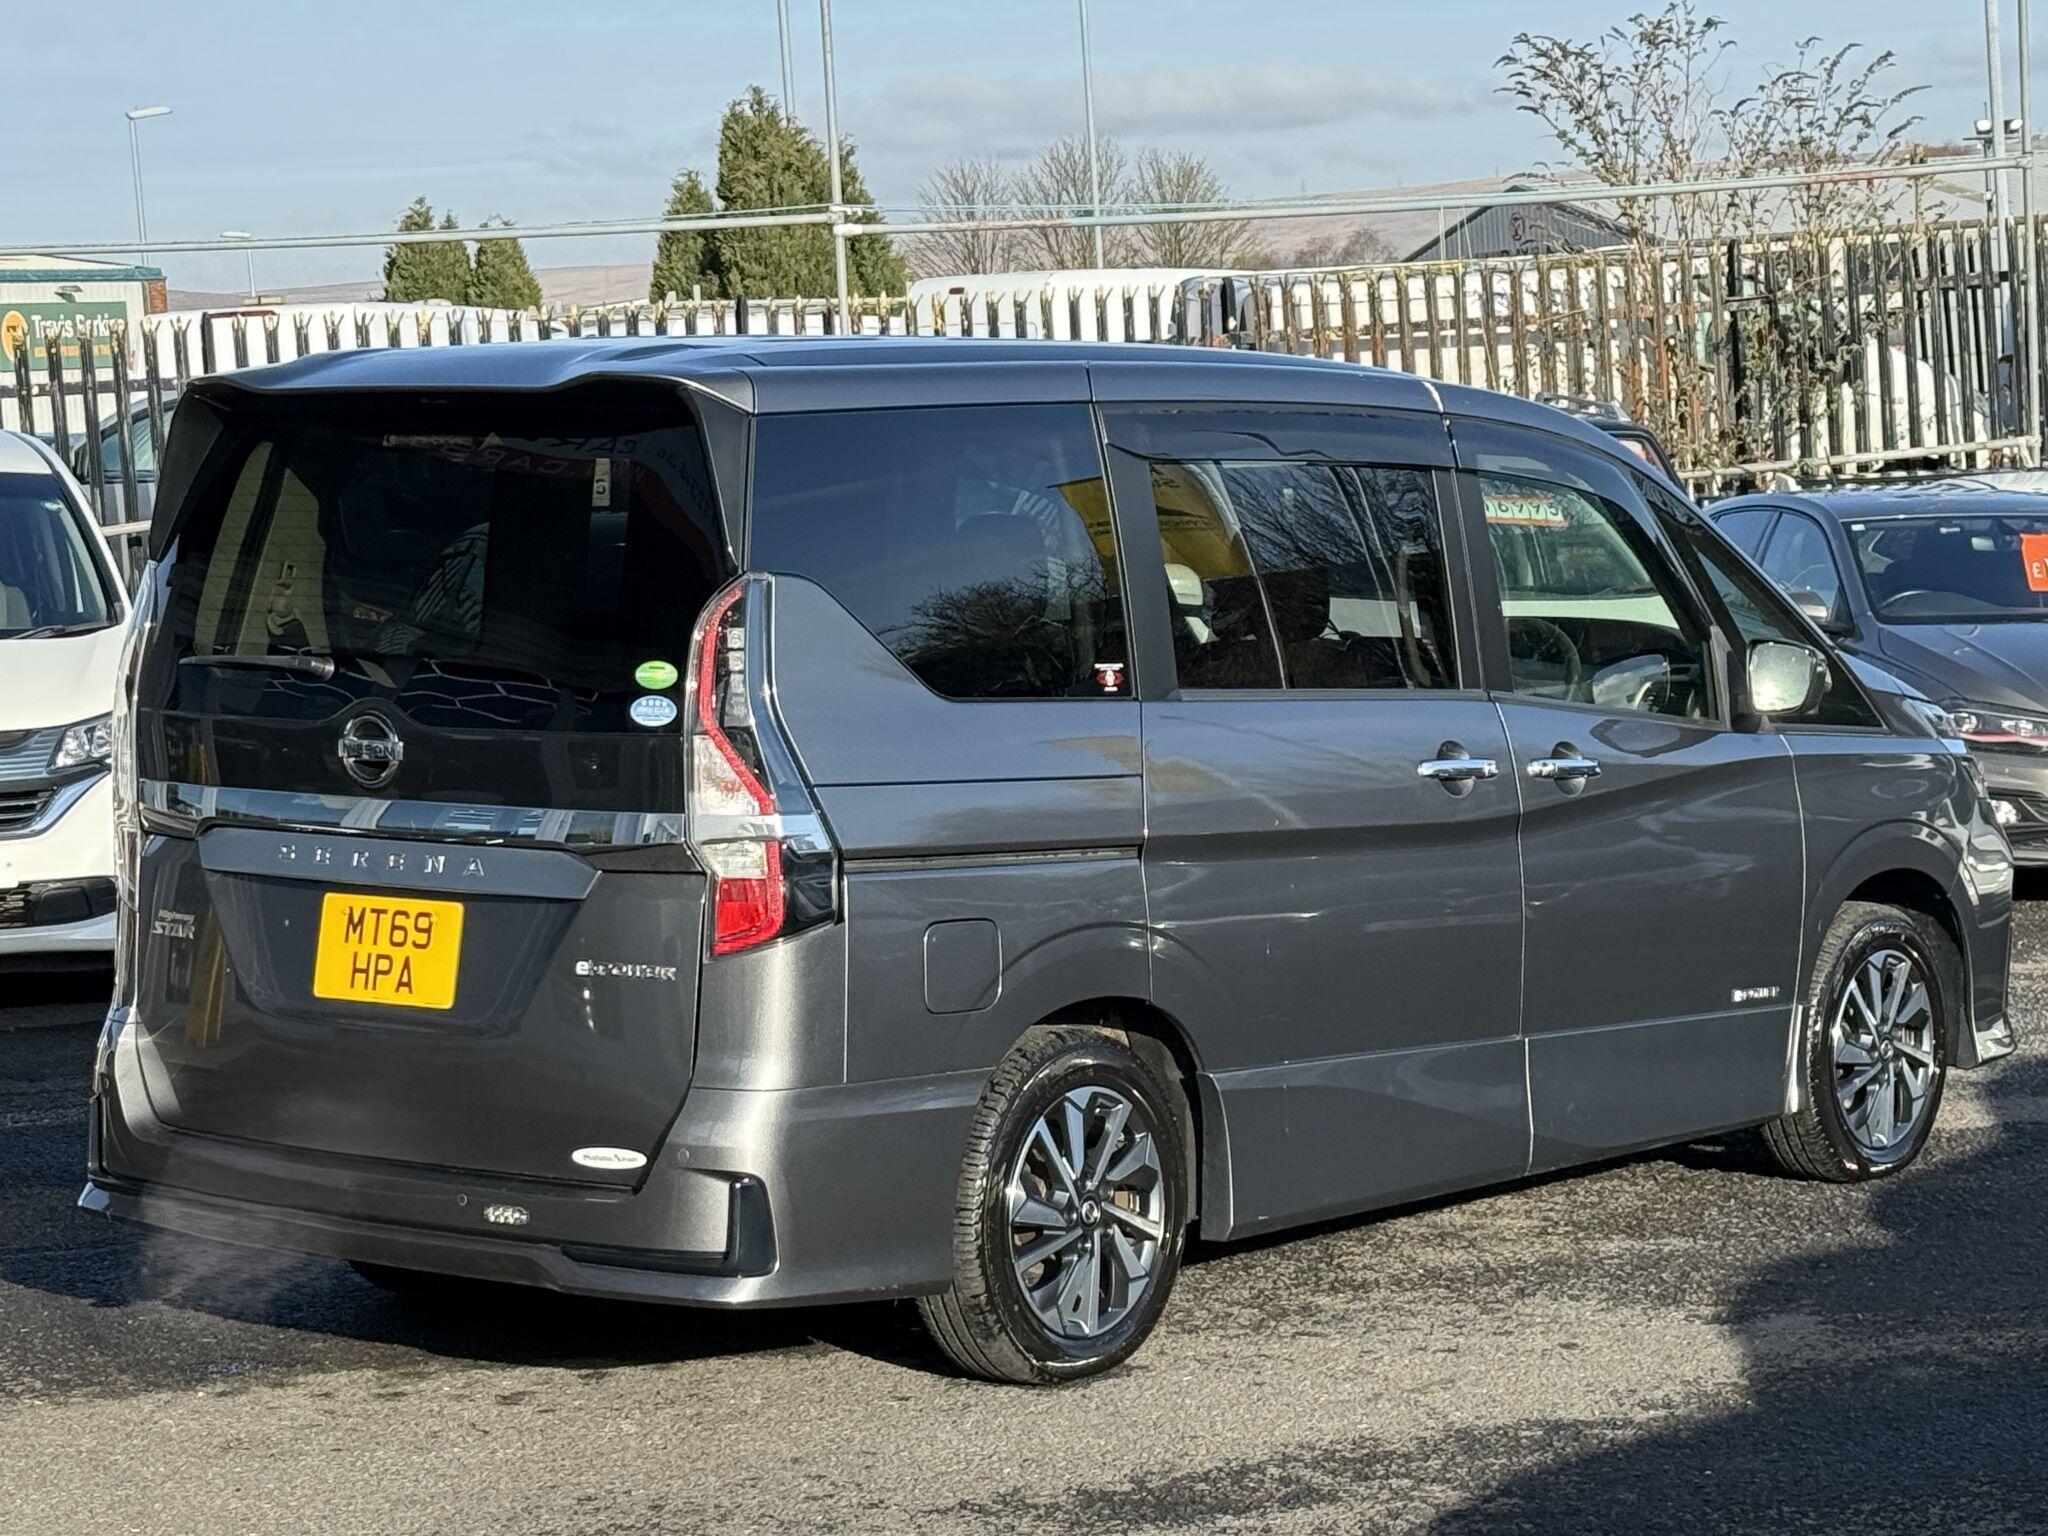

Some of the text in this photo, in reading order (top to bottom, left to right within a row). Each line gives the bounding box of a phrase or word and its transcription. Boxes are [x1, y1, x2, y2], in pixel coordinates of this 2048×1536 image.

[279, 844, 484, 877] SERENA
[152, 920, 196, 940] STAR
[344, 905, 434, 950] MT69
[350, 951, 413, 995] HPA
